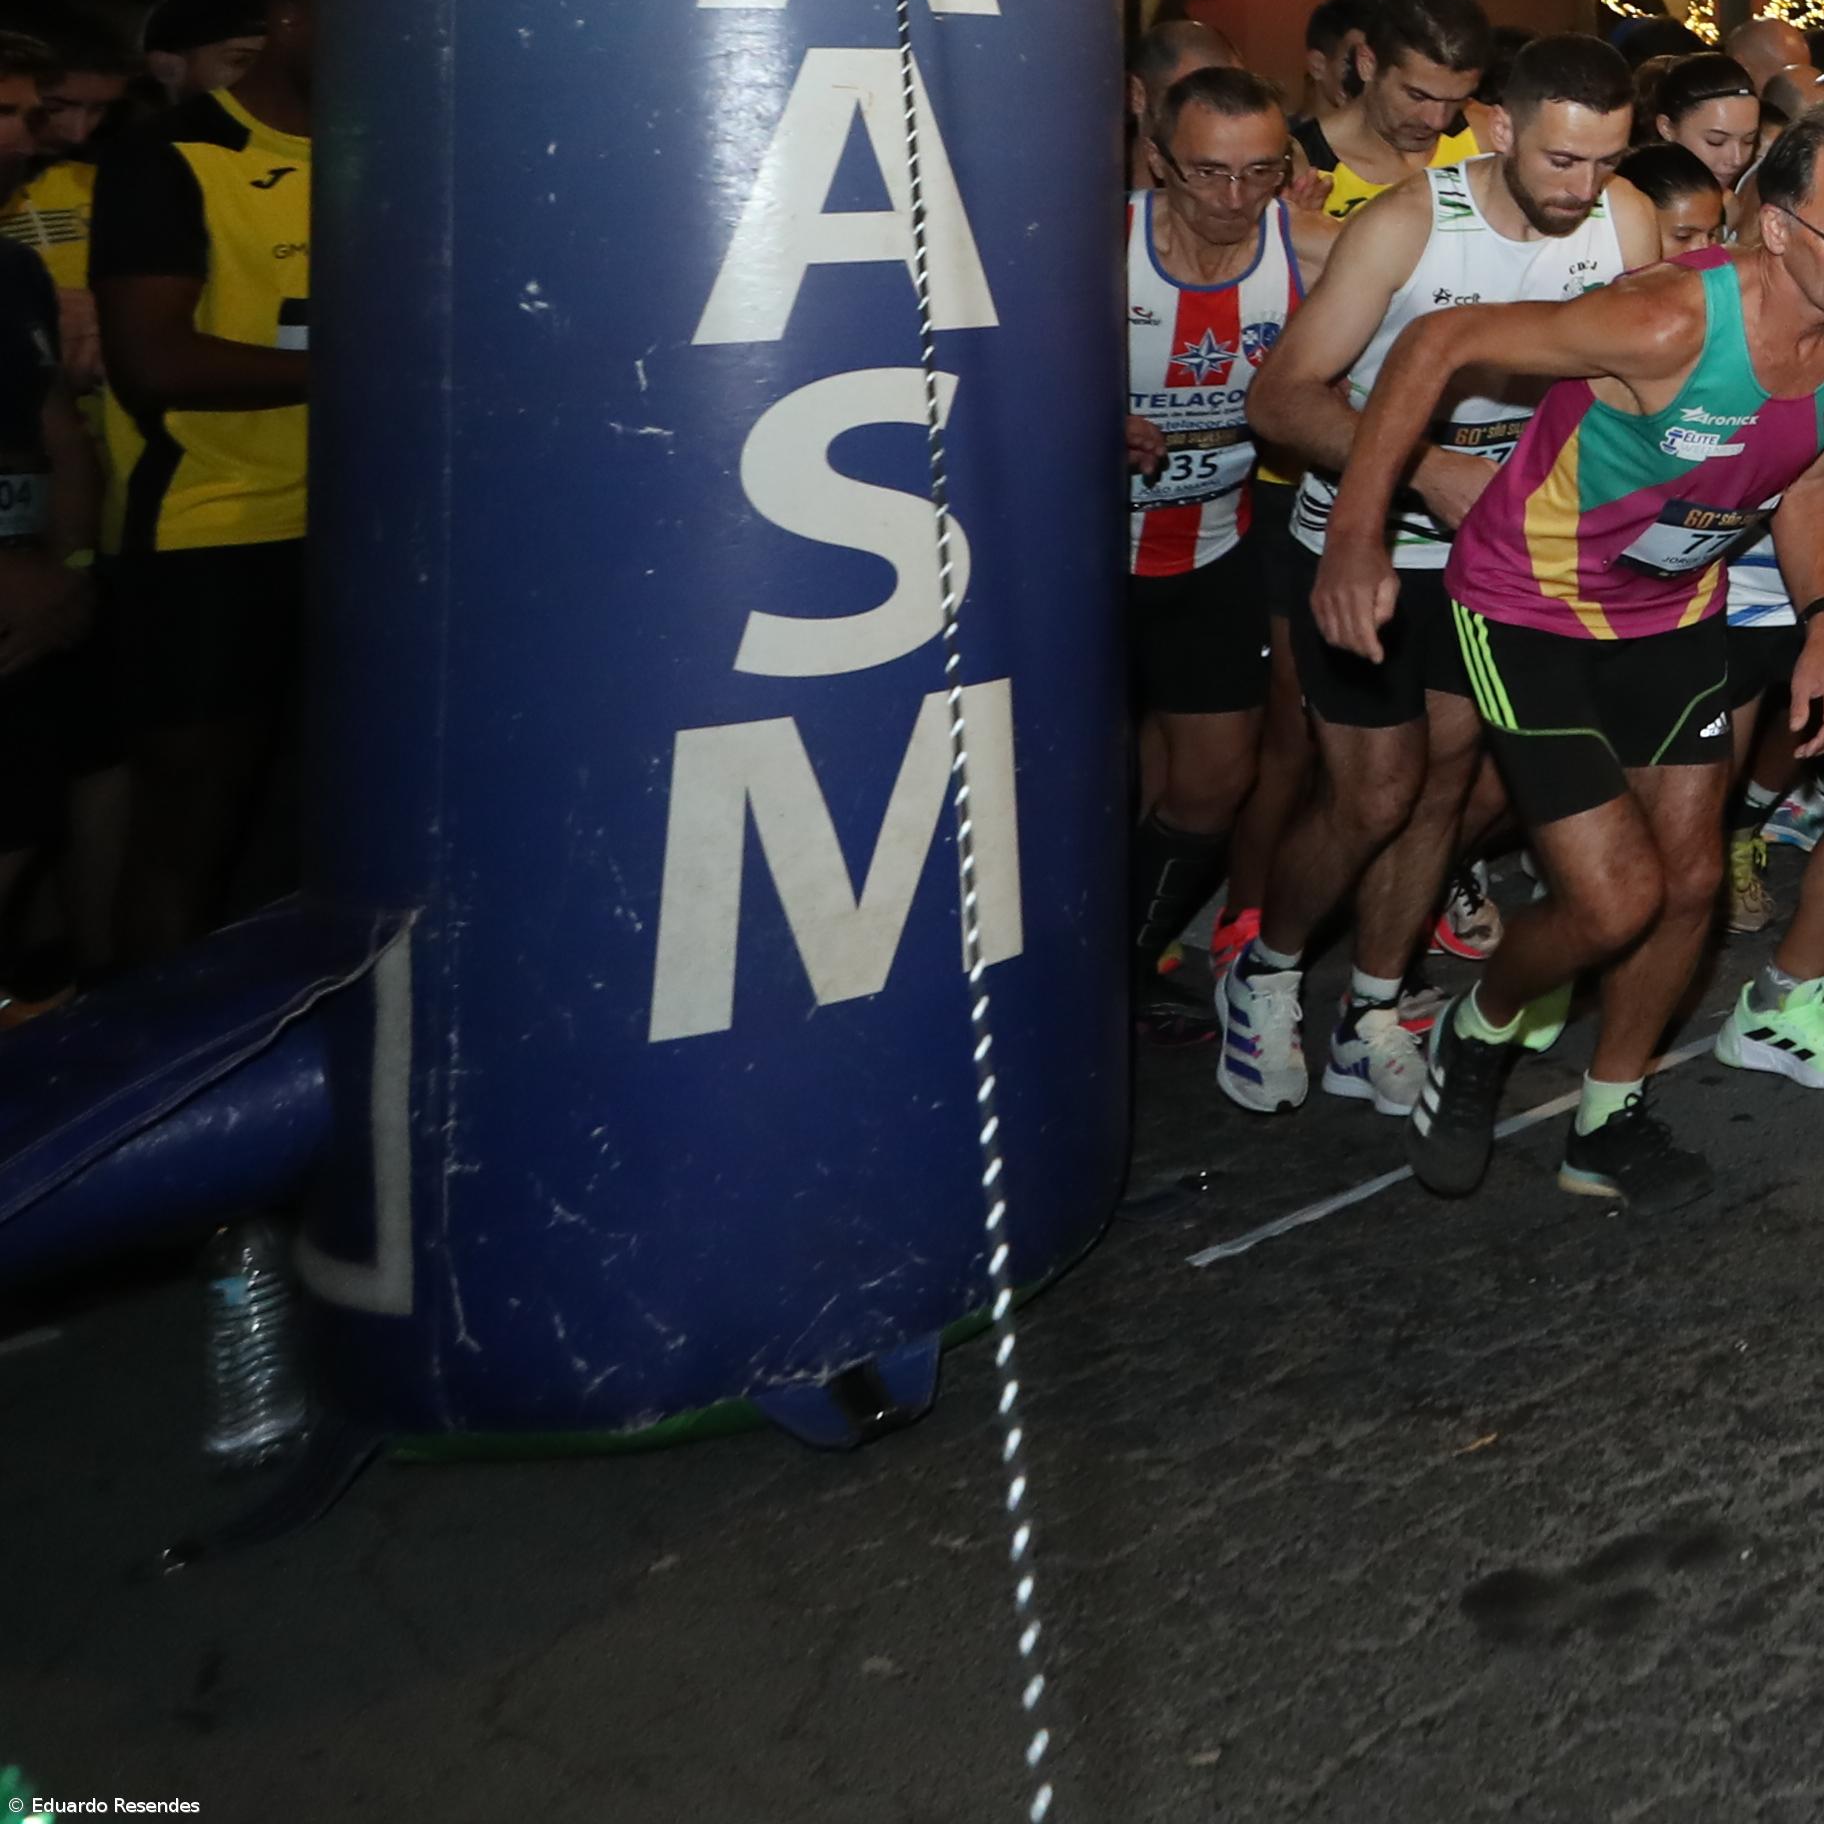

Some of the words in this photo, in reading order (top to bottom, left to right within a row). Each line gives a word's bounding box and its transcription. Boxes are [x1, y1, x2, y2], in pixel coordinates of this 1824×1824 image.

[1130, 389, 1246, 409] TELAÇO
[1683, 432, 1719, 446] ELITE
[1170, 452, 1219, 482] 35
